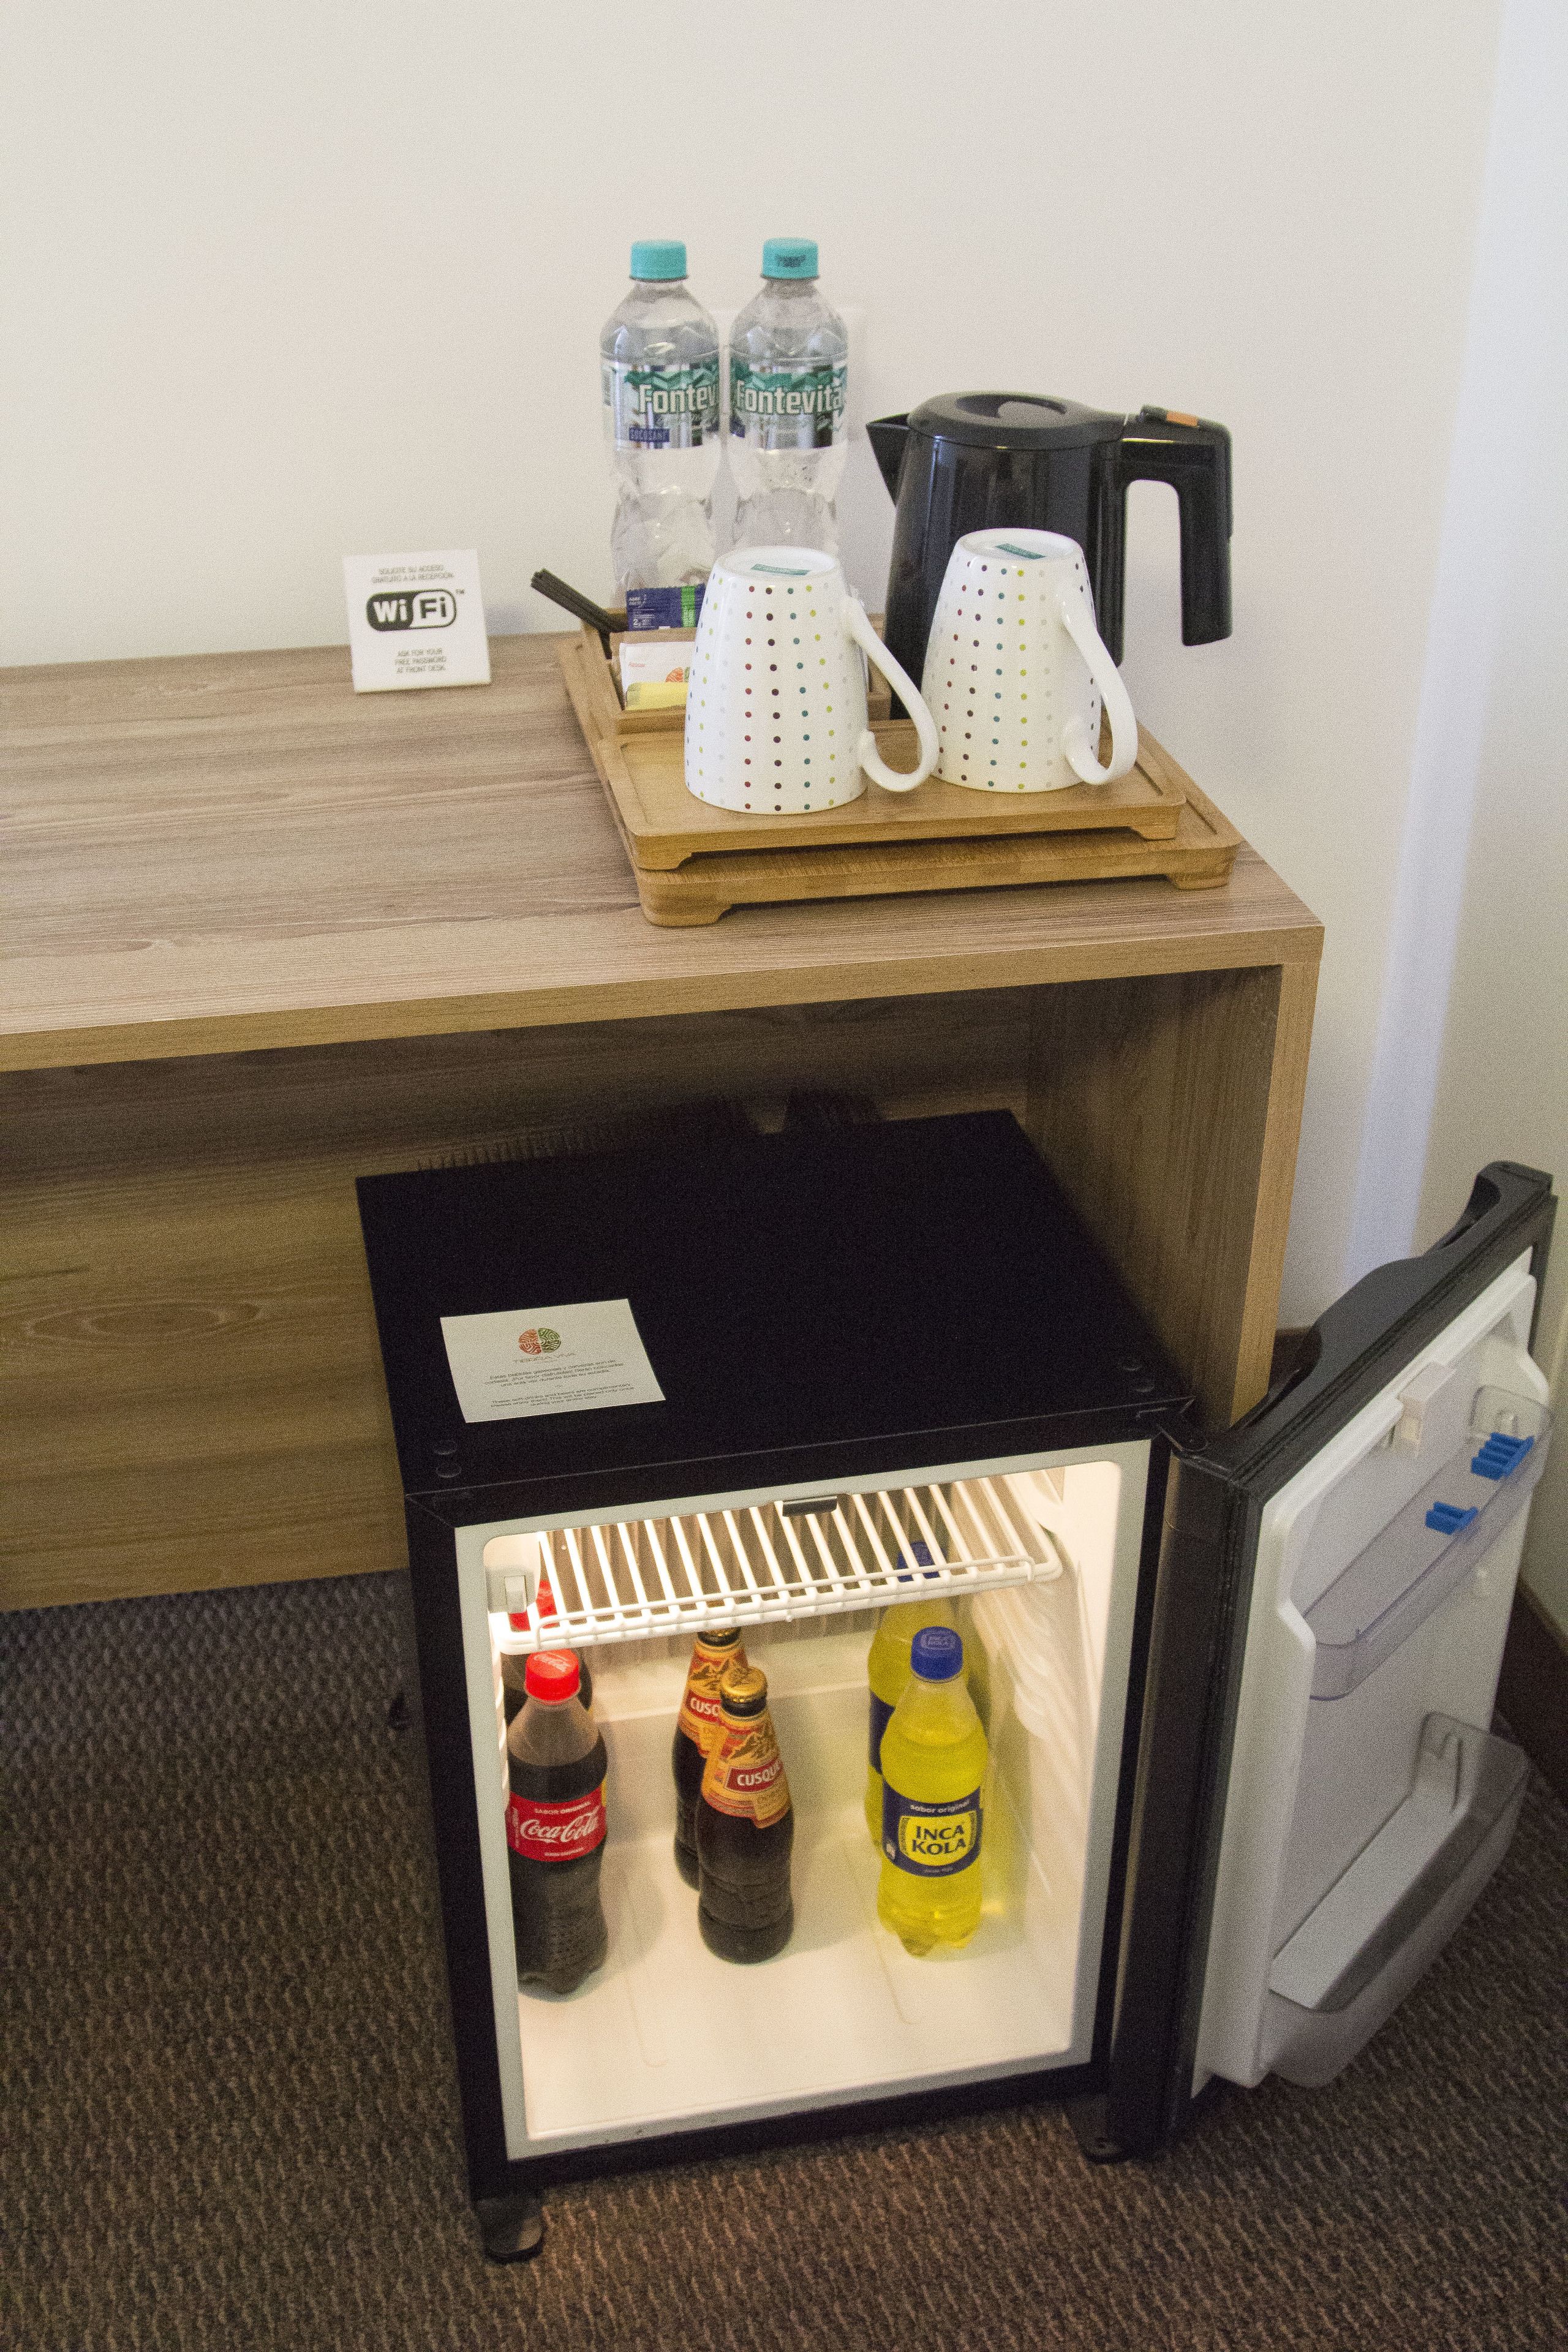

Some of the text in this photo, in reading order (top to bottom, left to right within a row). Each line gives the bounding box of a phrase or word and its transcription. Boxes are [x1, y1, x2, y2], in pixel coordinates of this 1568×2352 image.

[910, 1800, 970, 1814] sabor original
[916, 1825, 965, 1841] INCA
[912, 1838, 967, 1855] KOLA
